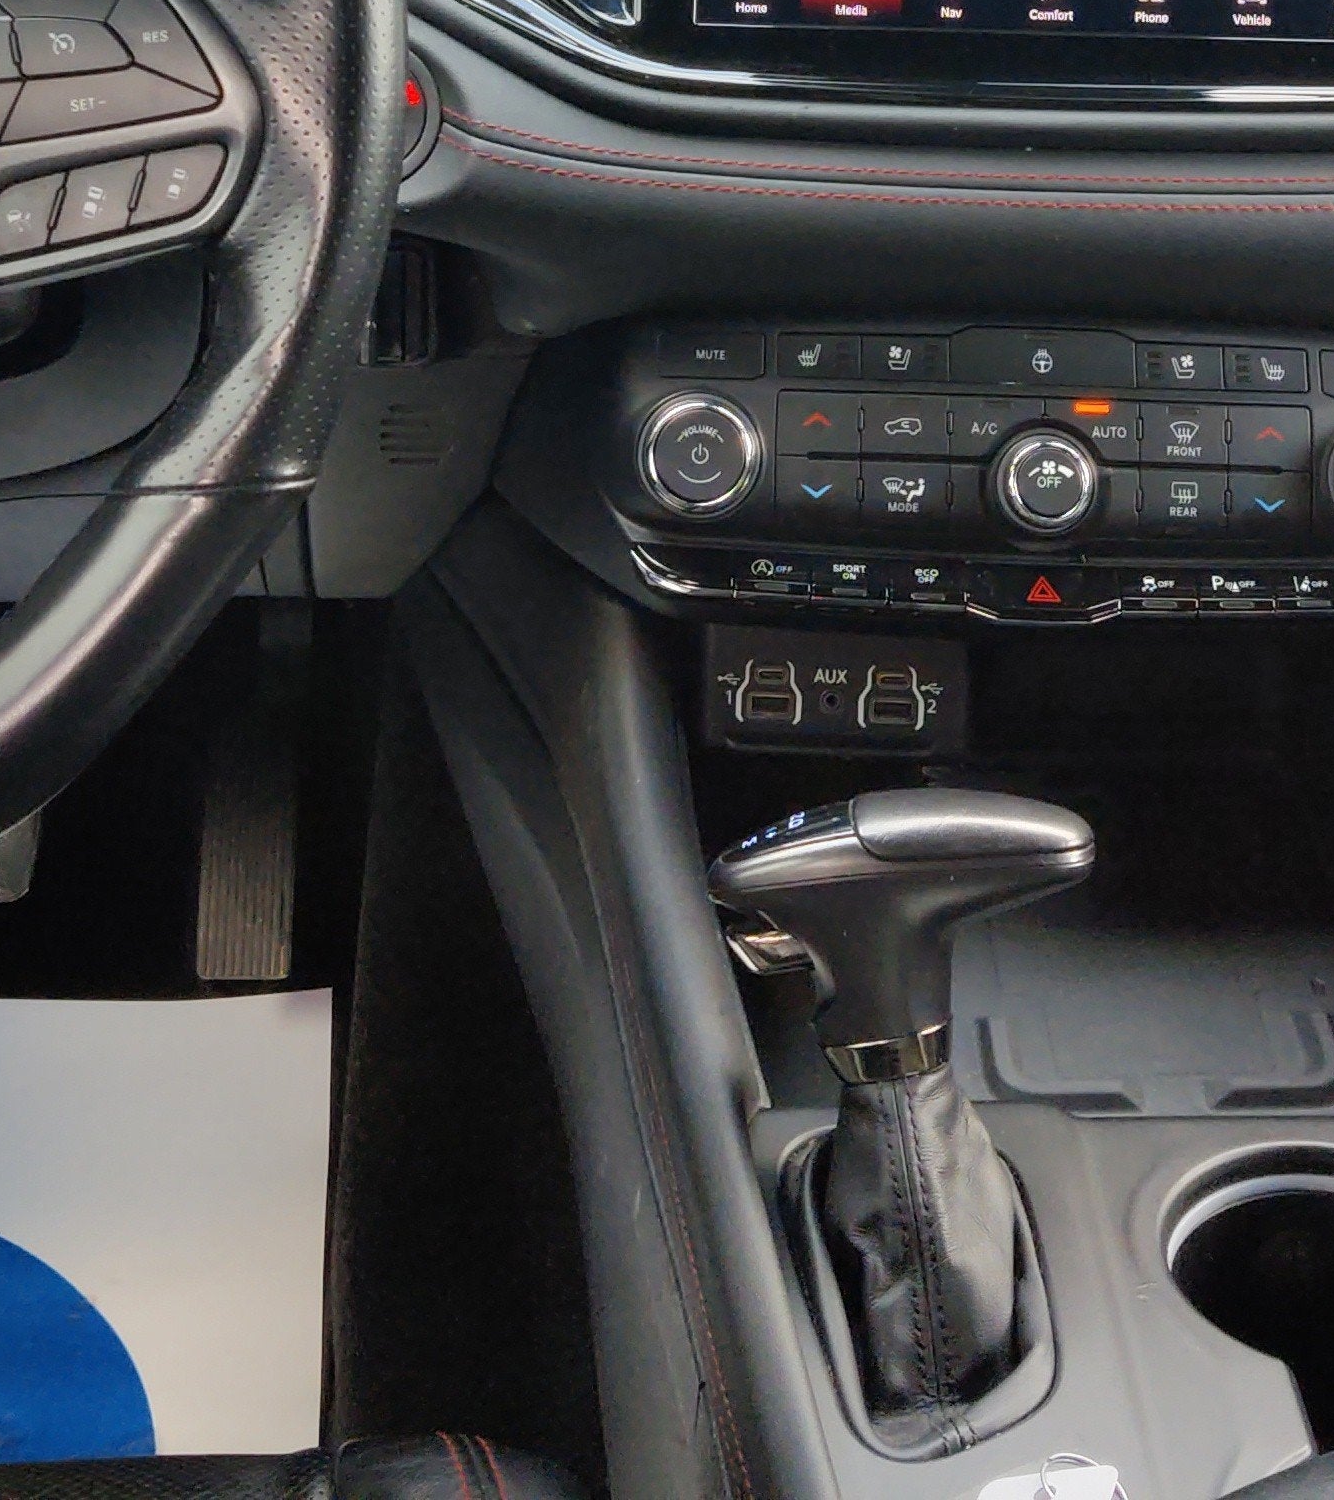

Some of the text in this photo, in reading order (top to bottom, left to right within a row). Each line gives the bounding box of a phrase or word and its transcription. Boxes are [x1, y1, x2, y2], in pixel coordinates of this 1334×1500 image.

[735, 2, 768, 14] Home
[835, 4, 868, 17] Media
[940, 7, 963, 19] Nav
[1029, 8, 1074, 21] Comfort
[1134, 11, 1169, 24] Phone
[1232, 13, 1272, 27] Vehicle
[142, 30, 170, 43] RES
[695, 349, 726, 361] MUTE
[683, 425, 719, 438] VOLUME
[971, 421, 998, 436] A/C
[1092, 425, 1127, 439] AUTO
[1166, 446, 1202, 458] FRONT
[1036, 476, 1062, 489] OFF
[887, 502, 919, 513] MODE
[1169, 505, 1198, 517] REAR
[775, 565, 794, 574] OFF
[832, 564, 867, 574] SPORT
[813, 667, 848, 685] AUX
[725, 689, 732, 705] 1
[926, 699, 937, 714] 2
